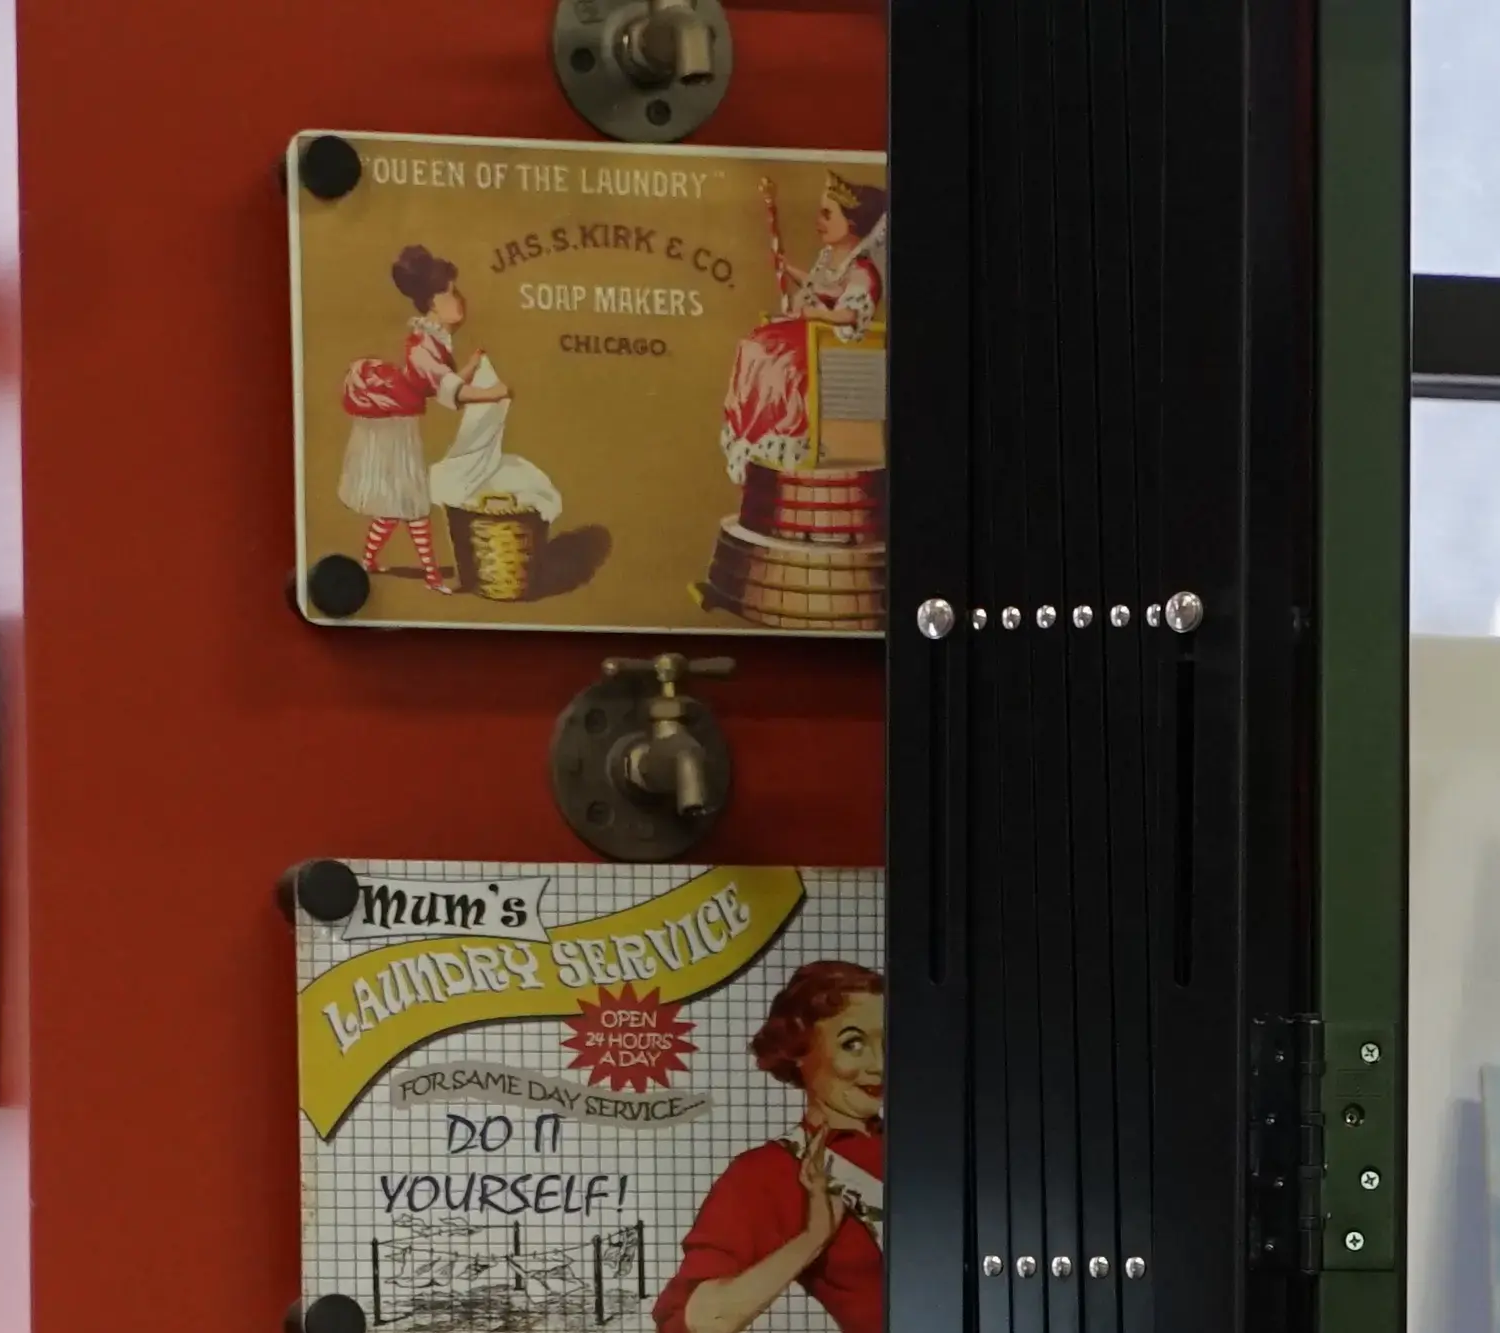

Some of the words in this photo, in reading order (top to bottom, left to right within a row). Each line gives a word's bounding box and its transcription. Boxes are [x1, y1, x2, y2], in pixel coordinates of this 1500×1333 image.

[476, 163, 507, 189] OF
[517, 165, 569, 193] THE
[520, 283, 585, 311] SOAP
[594, 286, 704, 317] MAKERS
[321, 940, 547, 1054] LAUNDRY
[551, 882, 752, 988] SERVICE
[601, 1010, 657, 1029] OPEN
[612, 1032, 673, 1050] HOURS
[619, 1051, 663, 1067] DAY
[452, 1070, 523, 1096] SAME
[528, 1081, 581, 1110] DAY
[446, 1114, 512, 1153] DO
[380, 1174, 629, 1216] YOURSELF!
